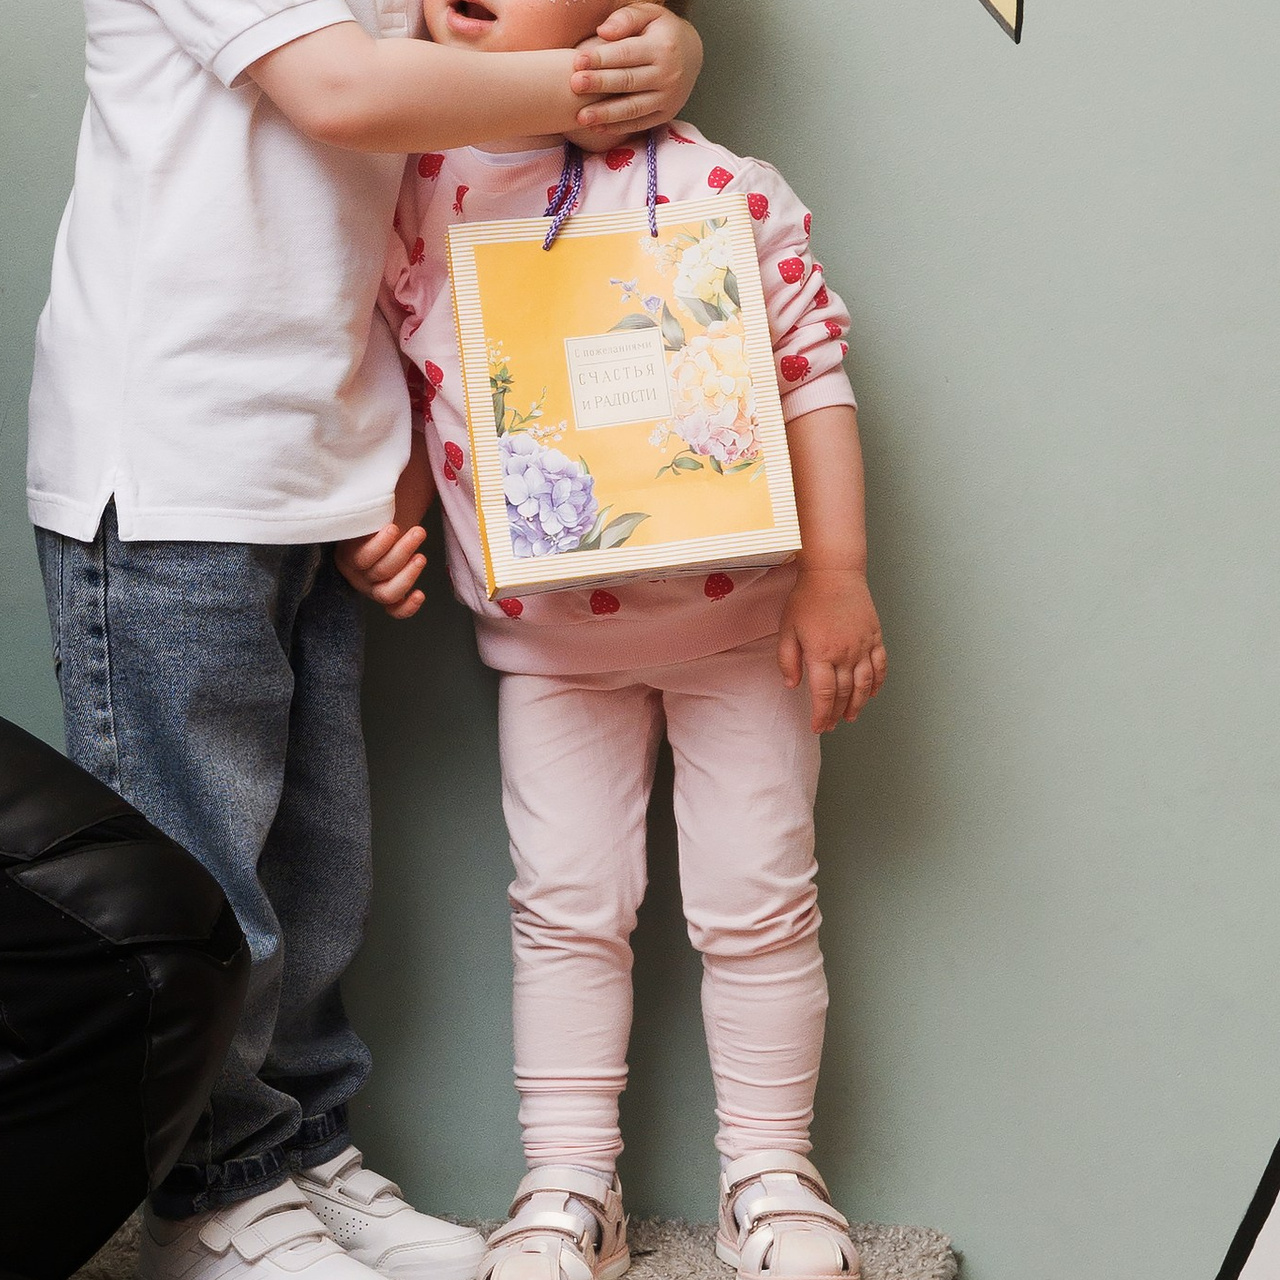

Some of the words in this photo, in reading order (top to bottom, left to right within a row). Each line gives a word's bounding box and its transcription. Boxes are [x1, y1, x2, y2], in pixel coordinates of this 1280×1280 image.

[583, 341, 652, 357] пожеланиями
[578, 363, 655, 386] СЧАСТЬЯ
[594, 388, 657, 409] РАДОСТИ
